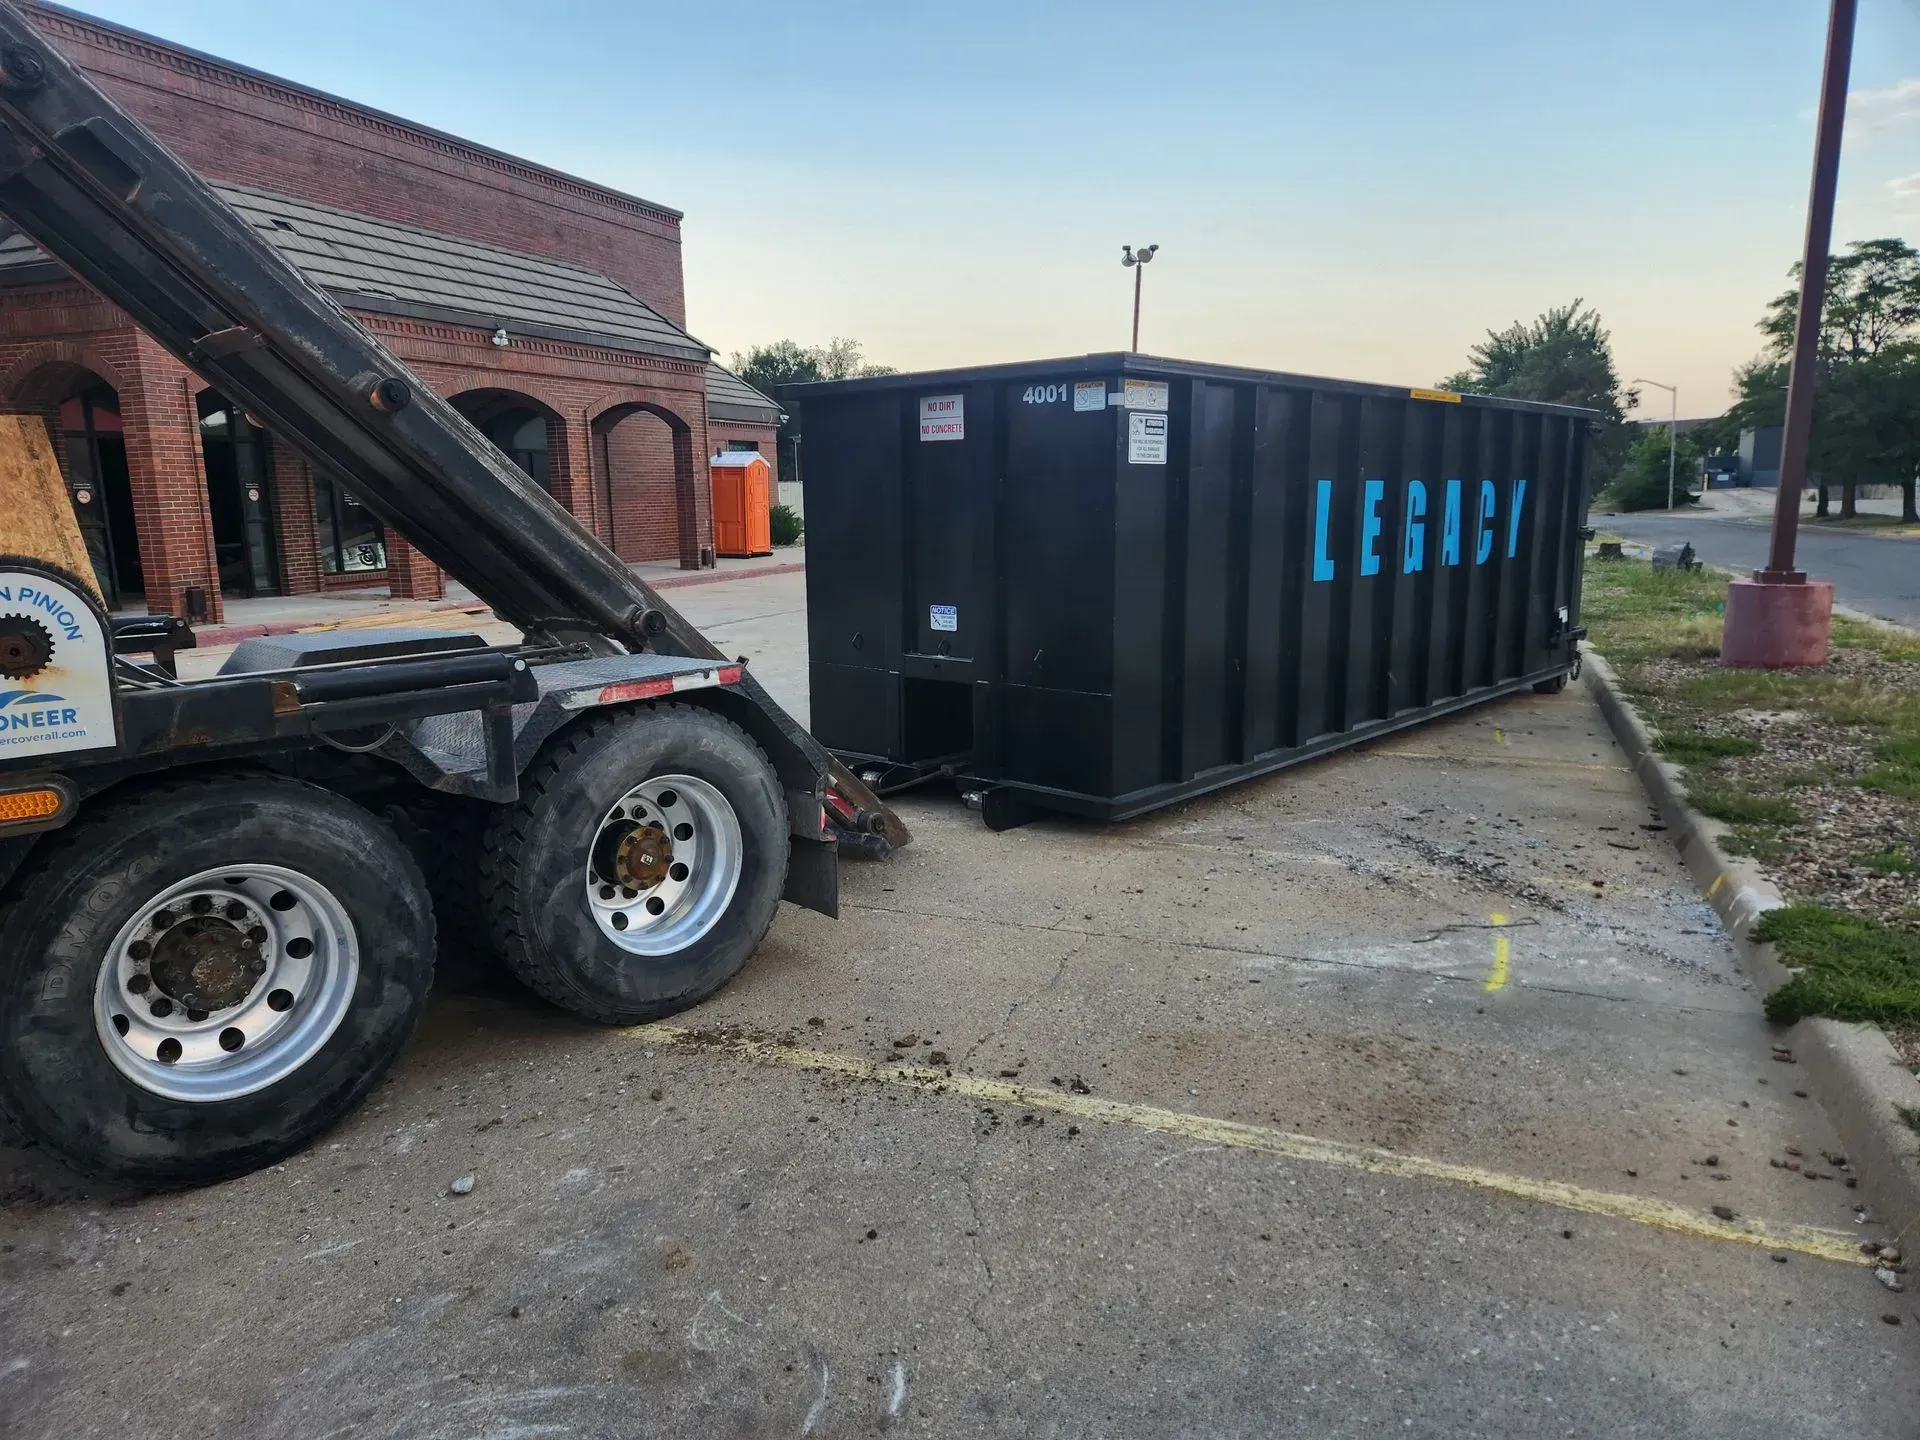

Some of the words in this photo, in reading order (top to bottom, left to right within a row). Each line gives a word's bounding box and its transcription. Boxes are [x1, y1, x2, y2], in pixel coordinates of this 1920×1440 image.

[1022, 384, 1067, 404] 4001
[928, 402, 937, 412] NO
[939, 401, 955, 411] DIRT
[922, 425, 930, 434] NO
[931, 424, 962, 434] CONCRETE
[1313, 479, 1527, 582] LEGACY
[18, 587, 83, 640] PINION
[932, 607, 955, 615] NOTICE
